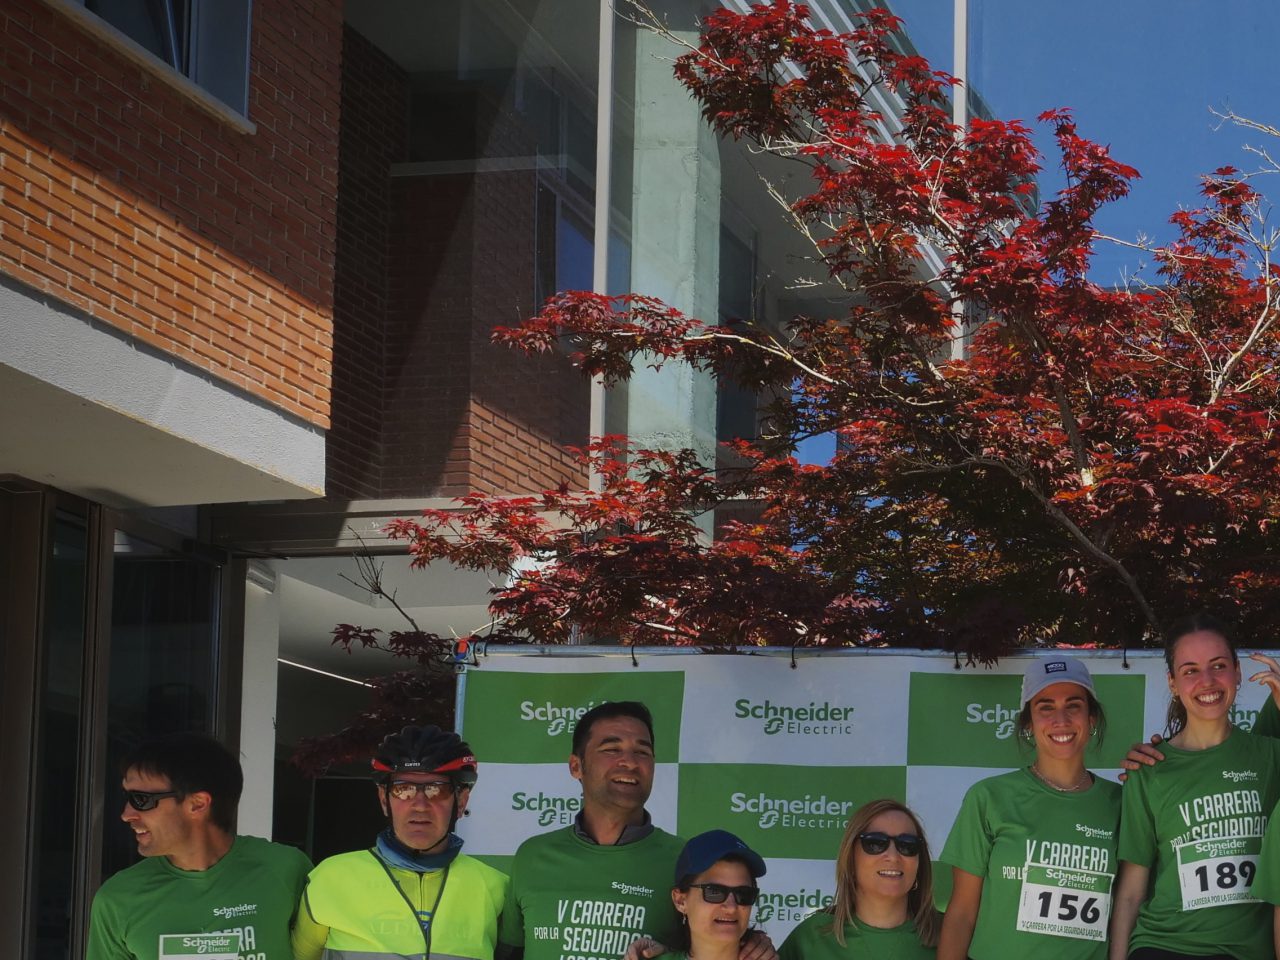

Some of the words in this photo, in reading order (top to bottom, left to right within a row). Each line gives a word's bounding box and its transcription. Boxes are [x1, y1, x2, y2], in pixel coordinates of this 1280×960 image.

[521, 701, 594, 721] Schne
[735, 699, 854, 721] Schneider
[787, 723, 852, 735] Electric
[512, 792, 583, 812] Schnei
[731, 792, 852, 815] Schneider
[1179, 802, 1191, 827] V
[1193, 790, 1262, 822] CARRERA
[782, 815, 849, 829] Electric
[1075, 823, 1112, 836] Schneider
[1195, 839, 1247, 853] Schneider
[1220, 848, 1247, 856] Electric
[1026, 839, 1037, 864] V
[1040, 841, 1109, 872] CARRERA
[1002, 866, 1016, 880] POR
[1046, 869, 1097, 884] Schneider
[1195, 861, 1256, 892] 189
[612, 881, 654, 895] Schneider
[1068, 881, 1095, 890] Electric
[213, 904, 257, 916] Schneider
[1038, 891, 1100, 924] 156
[557, 900, 569, 924] V
[571, 900, 646, 930] CARRERA
[534, 927, 548, 940] POR
[549, 927, 559, 940] LA
[183, 937, 230, 947] Schneider
